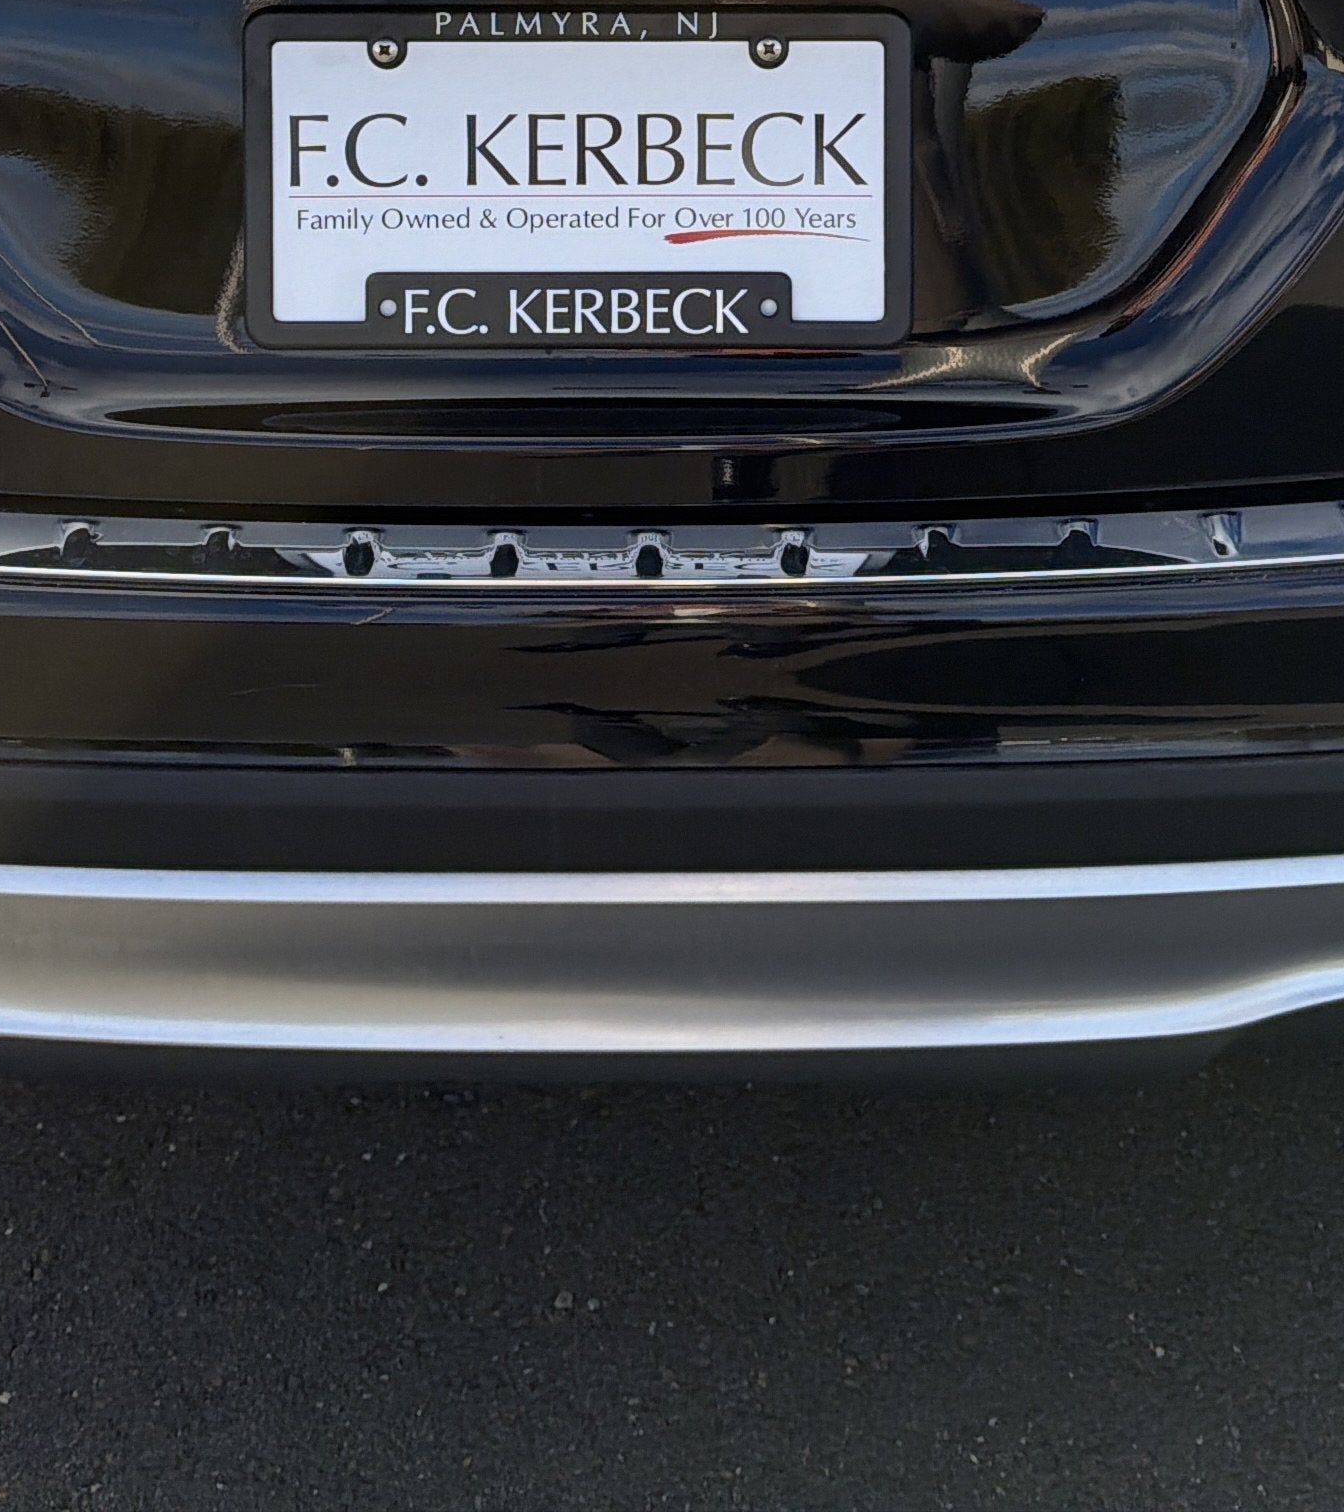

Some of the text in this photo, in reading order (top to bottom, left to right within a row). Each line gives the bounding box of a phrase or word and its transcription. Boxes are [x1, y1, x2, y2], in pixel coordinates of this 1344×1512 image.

[435, 11, 718, 40] PALMYRA, NJ
[288, 111, 868, 188] F.C. KERBECK
[297, 205, 857, 235] Family Owned & Operated For Over 100 Years
[404, 288, 749, 335] F.C. KERBECK
